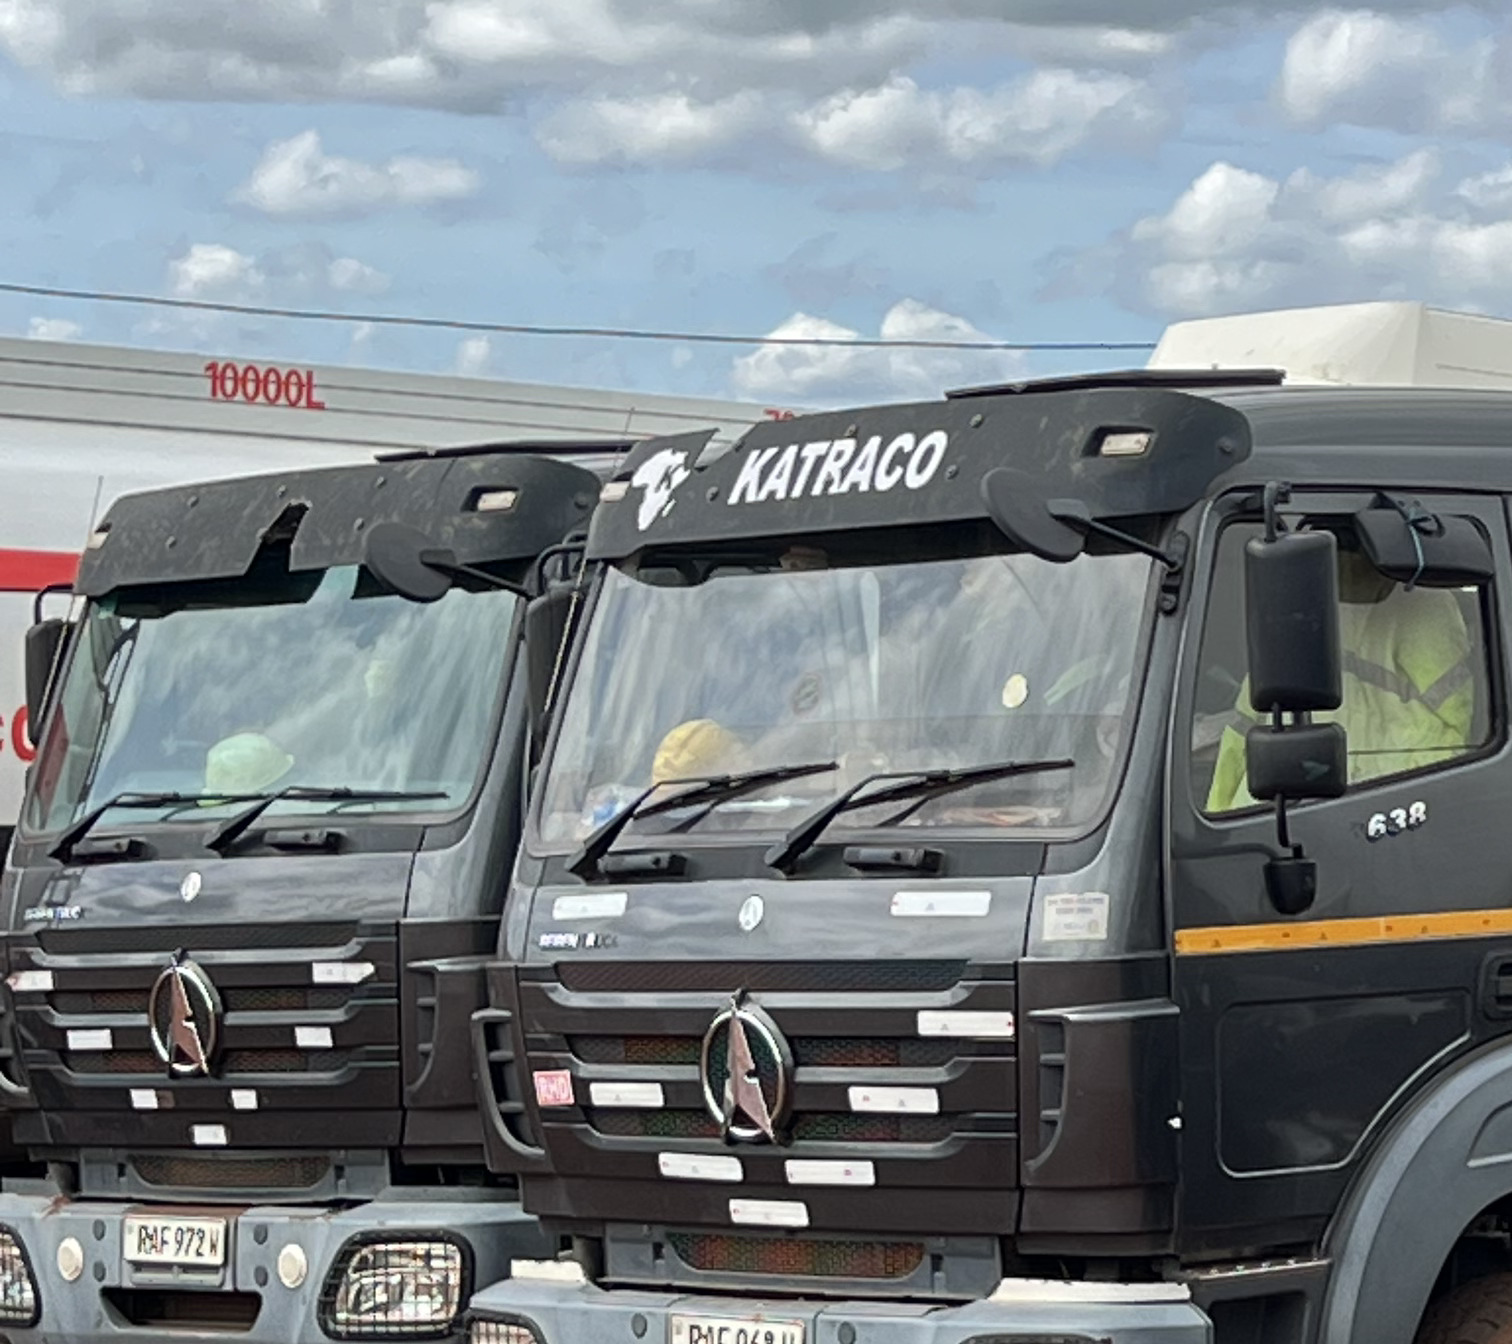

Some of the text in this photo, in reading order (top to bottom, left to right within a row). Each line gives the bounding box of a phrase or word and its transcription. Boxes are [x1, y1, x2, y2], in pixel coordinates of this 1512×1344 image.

[204, 361, 326, 409] 10000L
[727, 430, 949, 505] KATRACO
[1367, 801, 1427, 843] 638
[138, 1224, 171, 1254] RAF
[175, 1225, 205, 1257] 972
